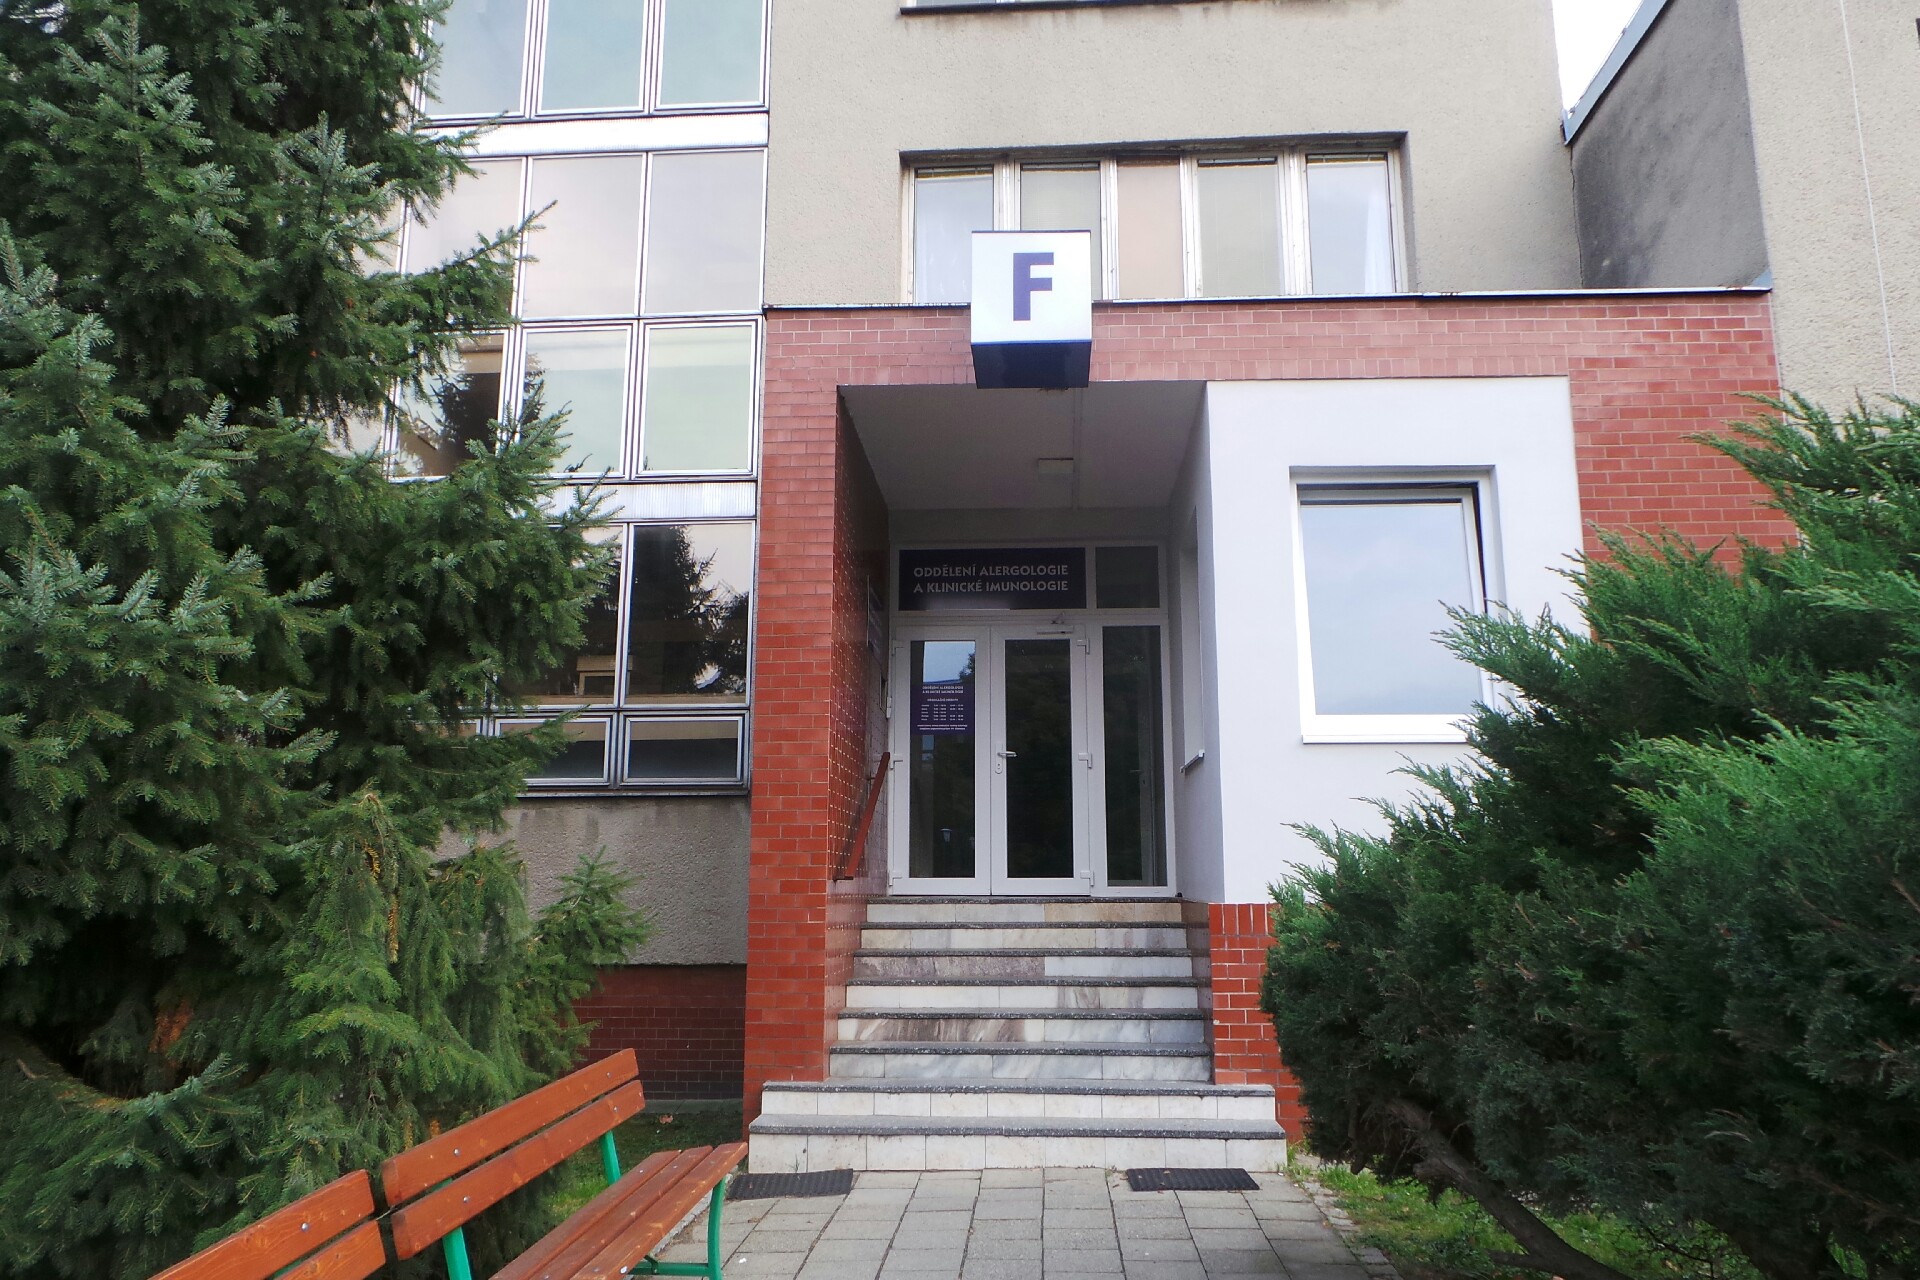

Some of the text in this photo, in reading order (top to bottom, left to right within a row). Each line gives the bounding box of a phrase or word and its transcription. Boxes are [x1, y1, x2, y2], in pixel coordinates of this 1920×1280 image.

[1012, 251, 1055, 322] F
[913, 564, 1069, 578] ODDĚLENÍ ALERGOLOGIE
[913, 579, 1069, 593] A KLINICKÉ IMUNOLOGIE
